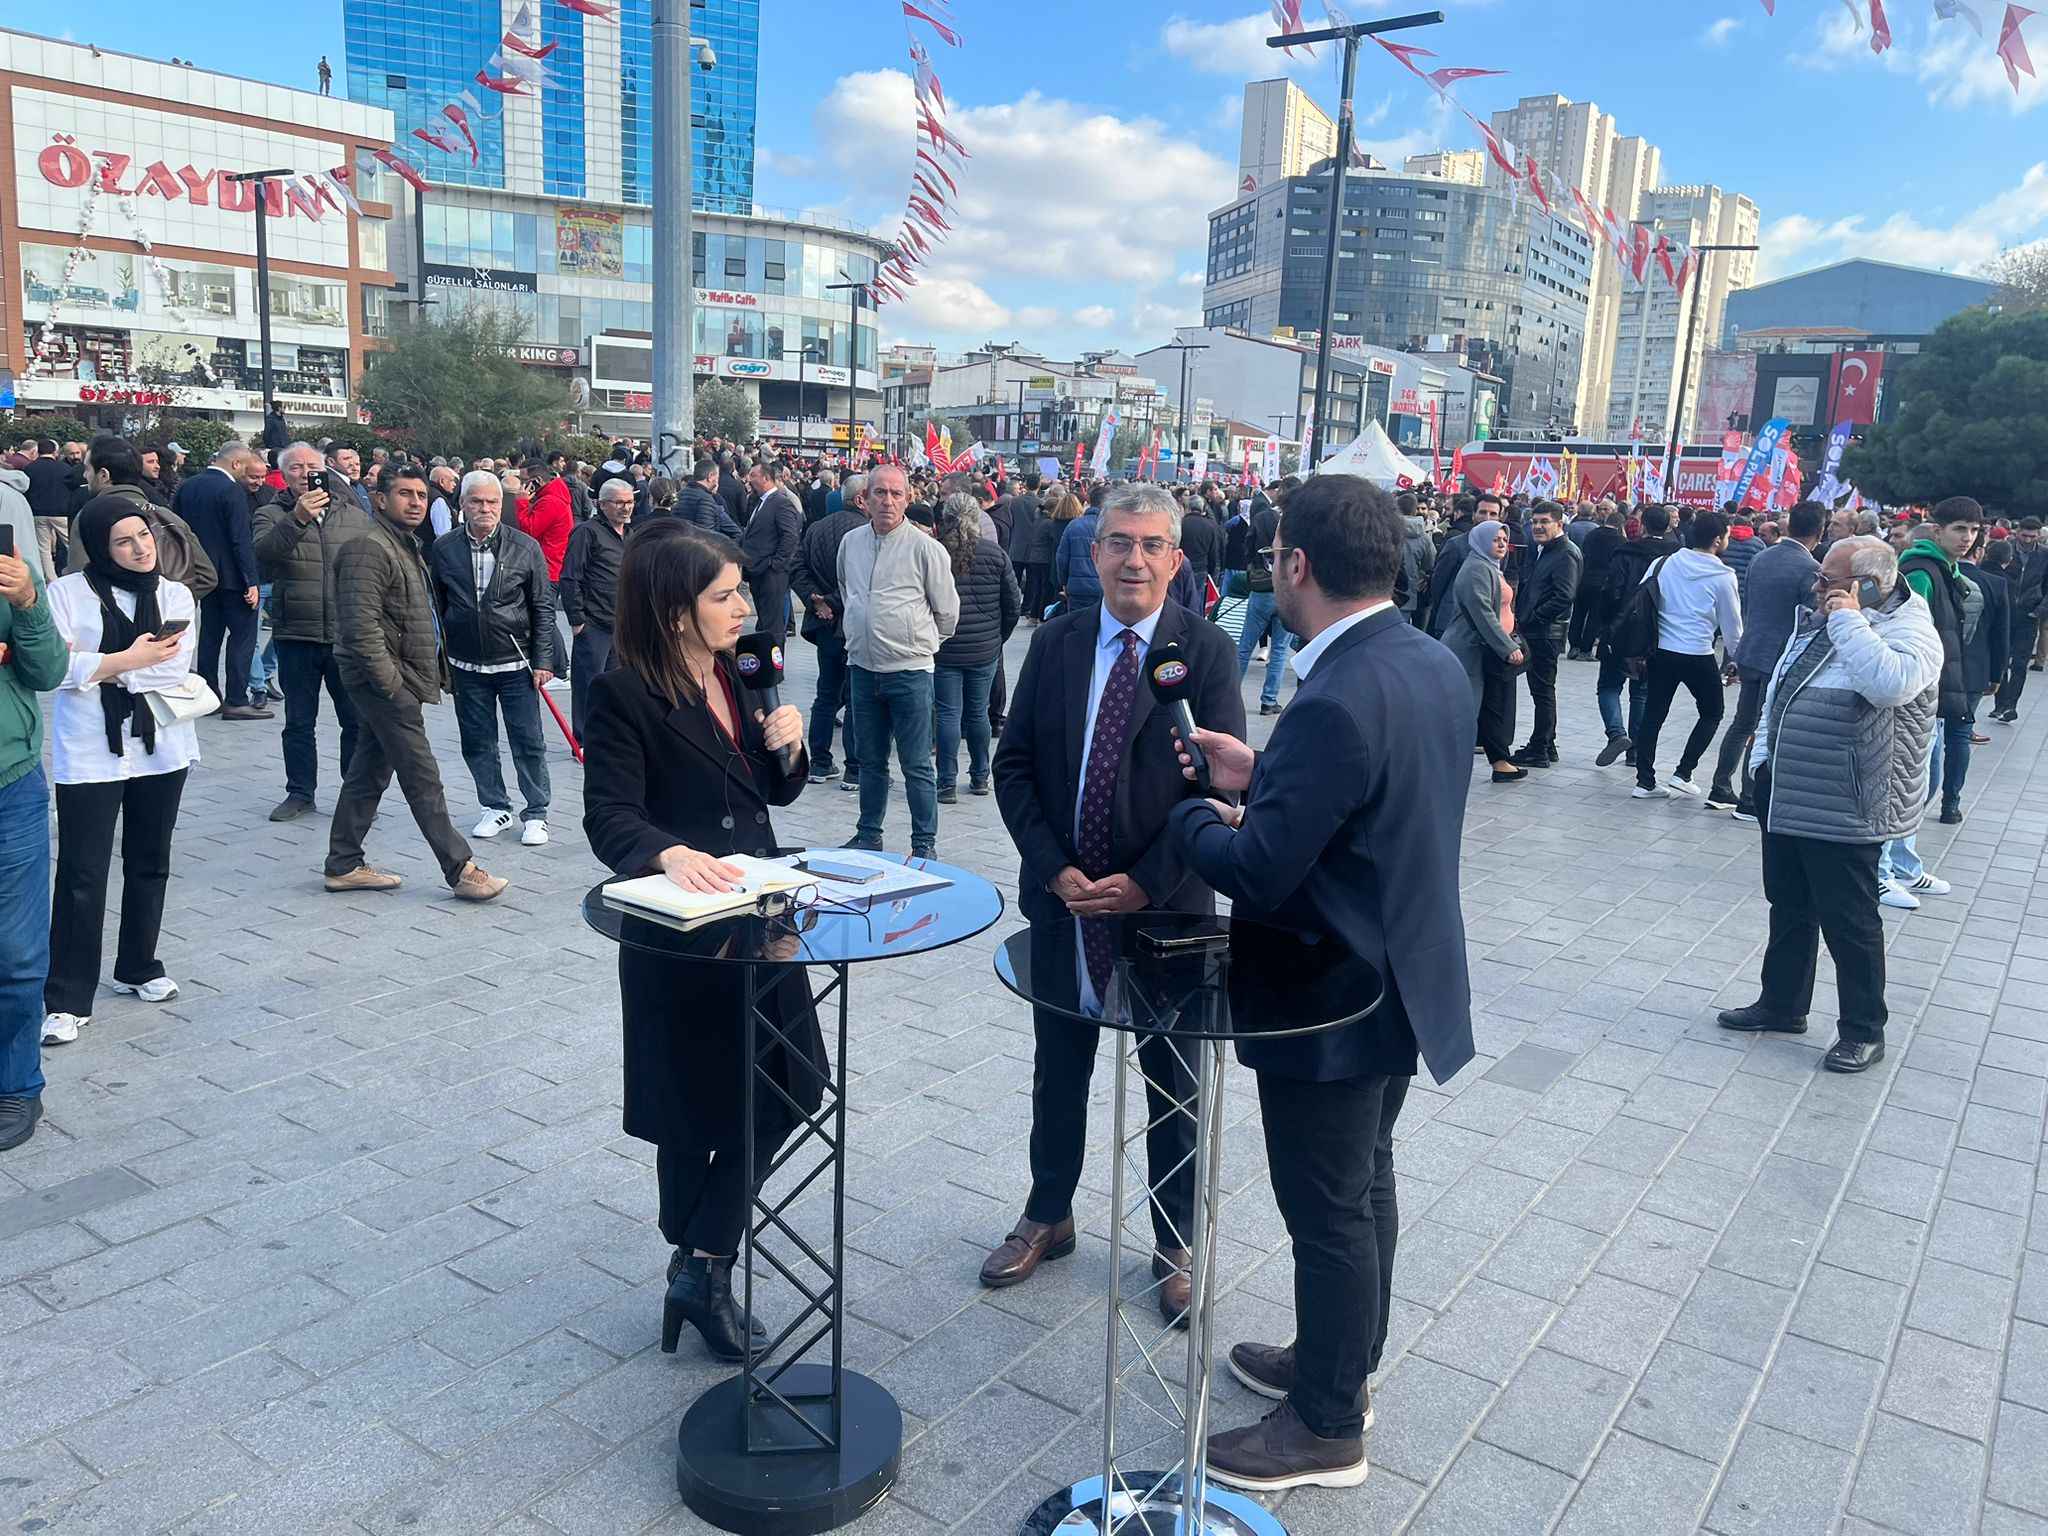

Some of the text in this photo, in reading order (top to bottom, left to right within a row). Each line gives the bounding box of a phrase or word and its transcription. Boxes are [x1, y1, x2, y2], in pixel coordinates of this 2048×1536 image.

[38, 132, 327, 223] ÖZAYDIN
[427, 275, 528, 292] GÜZELLİK SALONLARI
[709, 291, 757, 305] Waffle Caffe
[1315, 336, 1361, 349] EBARK
[520, 347, 557, 361] KING
[731, 361, 767, 374] çağrı
[1752, 425, 1779, 465] SOL
[1826, 434, 1845, 472] SOL
[738, 658, 757, 670] SZC
[1159, 665, 1184, 680] SZC
